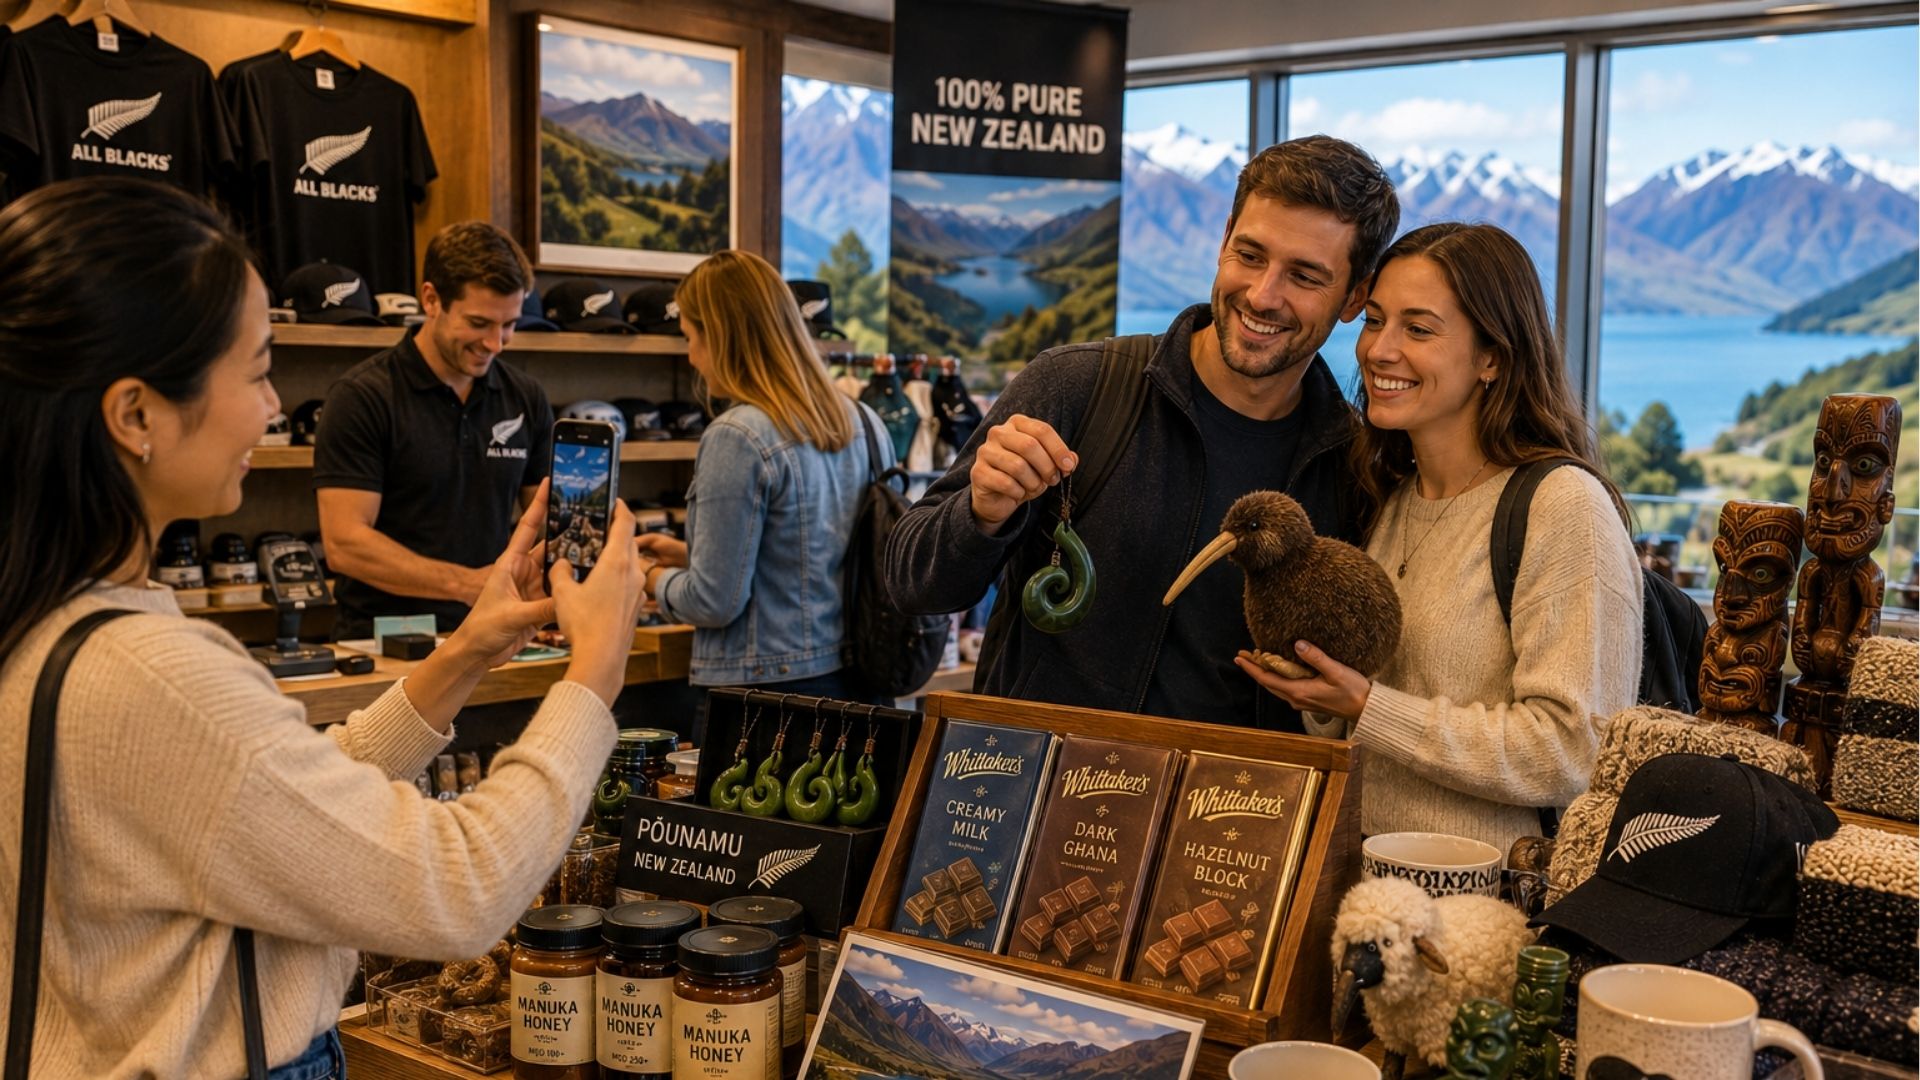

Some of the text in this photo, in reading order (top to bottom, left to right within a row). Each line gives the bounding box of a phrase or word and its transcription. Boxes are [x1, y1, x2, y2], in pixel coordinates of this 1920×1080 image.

[935, 76, 1082, 117] 100% PURE
[911, 112, 1106, 155] NEW ZEALAND
[71, 143, 102, 162] ALL
[293, 178, 319, 196] ALL
[943, 747, 1024, 780] Whittaker's
[1061, 765, 1150, 800] Whittaker's
[946, 799, 1007, 824] CREAMY
[1187, 785, 1285, 821] Whittaker's
[952, 820, 990, 841] MILK
[1074, 821, 1118, 843] DARK
[1063, 840, 1118, 864] GHANA
[1184, 841, 1271, 871] HAZELNUT
[634, 851, 736, 885] NEW ZEALAND
[1193, 864, 1249, 890] BLOCK
[518, 995, 578, 1015] MANUKA
[602, 996, 662, 1018] MANUKA
[524, 1013, 571, 1032] HONEY
[606, 1016, 655, 1037] HONEY
[683, 1023, 751, 1044] MANUKA
[690, 1044, 744, 1063] HONEY
